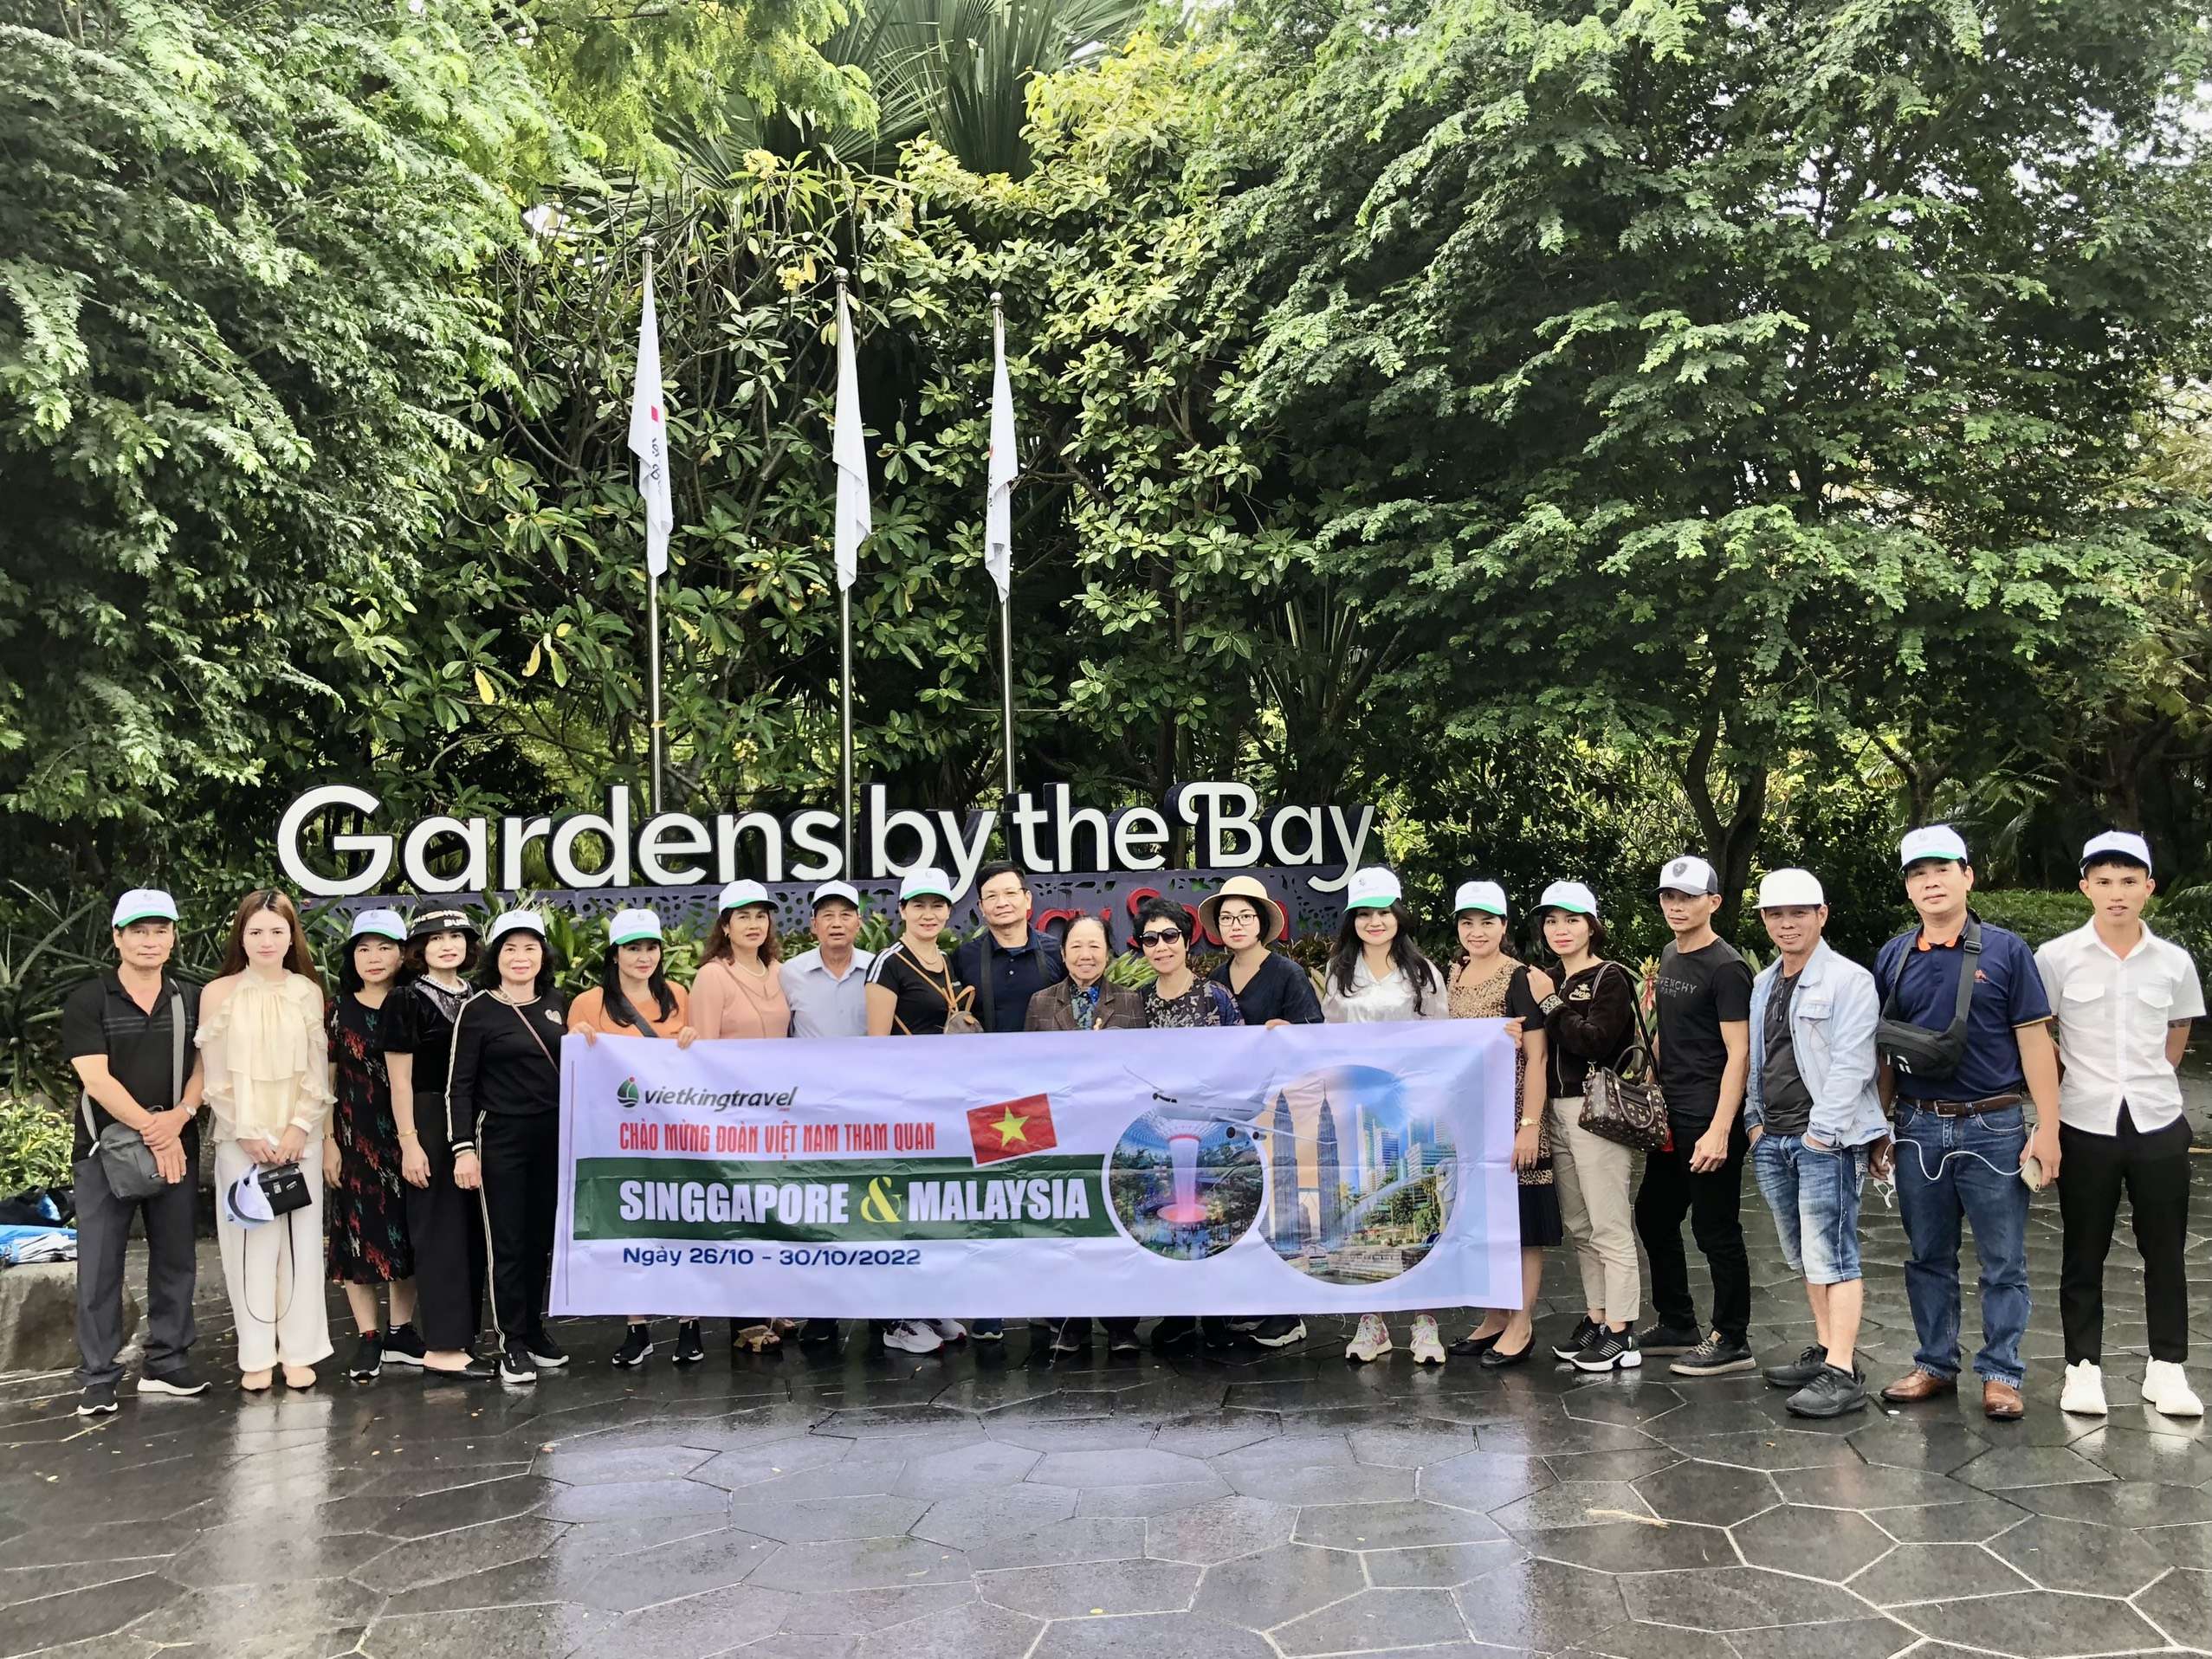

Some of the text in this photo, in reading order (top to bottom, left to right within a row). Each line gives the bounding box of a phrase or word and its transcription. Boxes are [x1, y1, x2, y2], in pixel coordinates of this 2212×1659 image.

[276, 781, 1375, 904] Gardens by the Bay
[644, 1086, 799, 1113] vietkingtravel
[619, 1118, 935, 1160] CHÀO MỪNG ĐOÀN VIỆT NAM THAM QUAN
[618, 1176, 1090, 1224] SINGGAPORE & MALAYSIA
[623, 1247, 682, 1266] Ngày
[689, 1248, 754, 1264] 26/10
[779, 1249, 922, 1266] 30/10/2022
